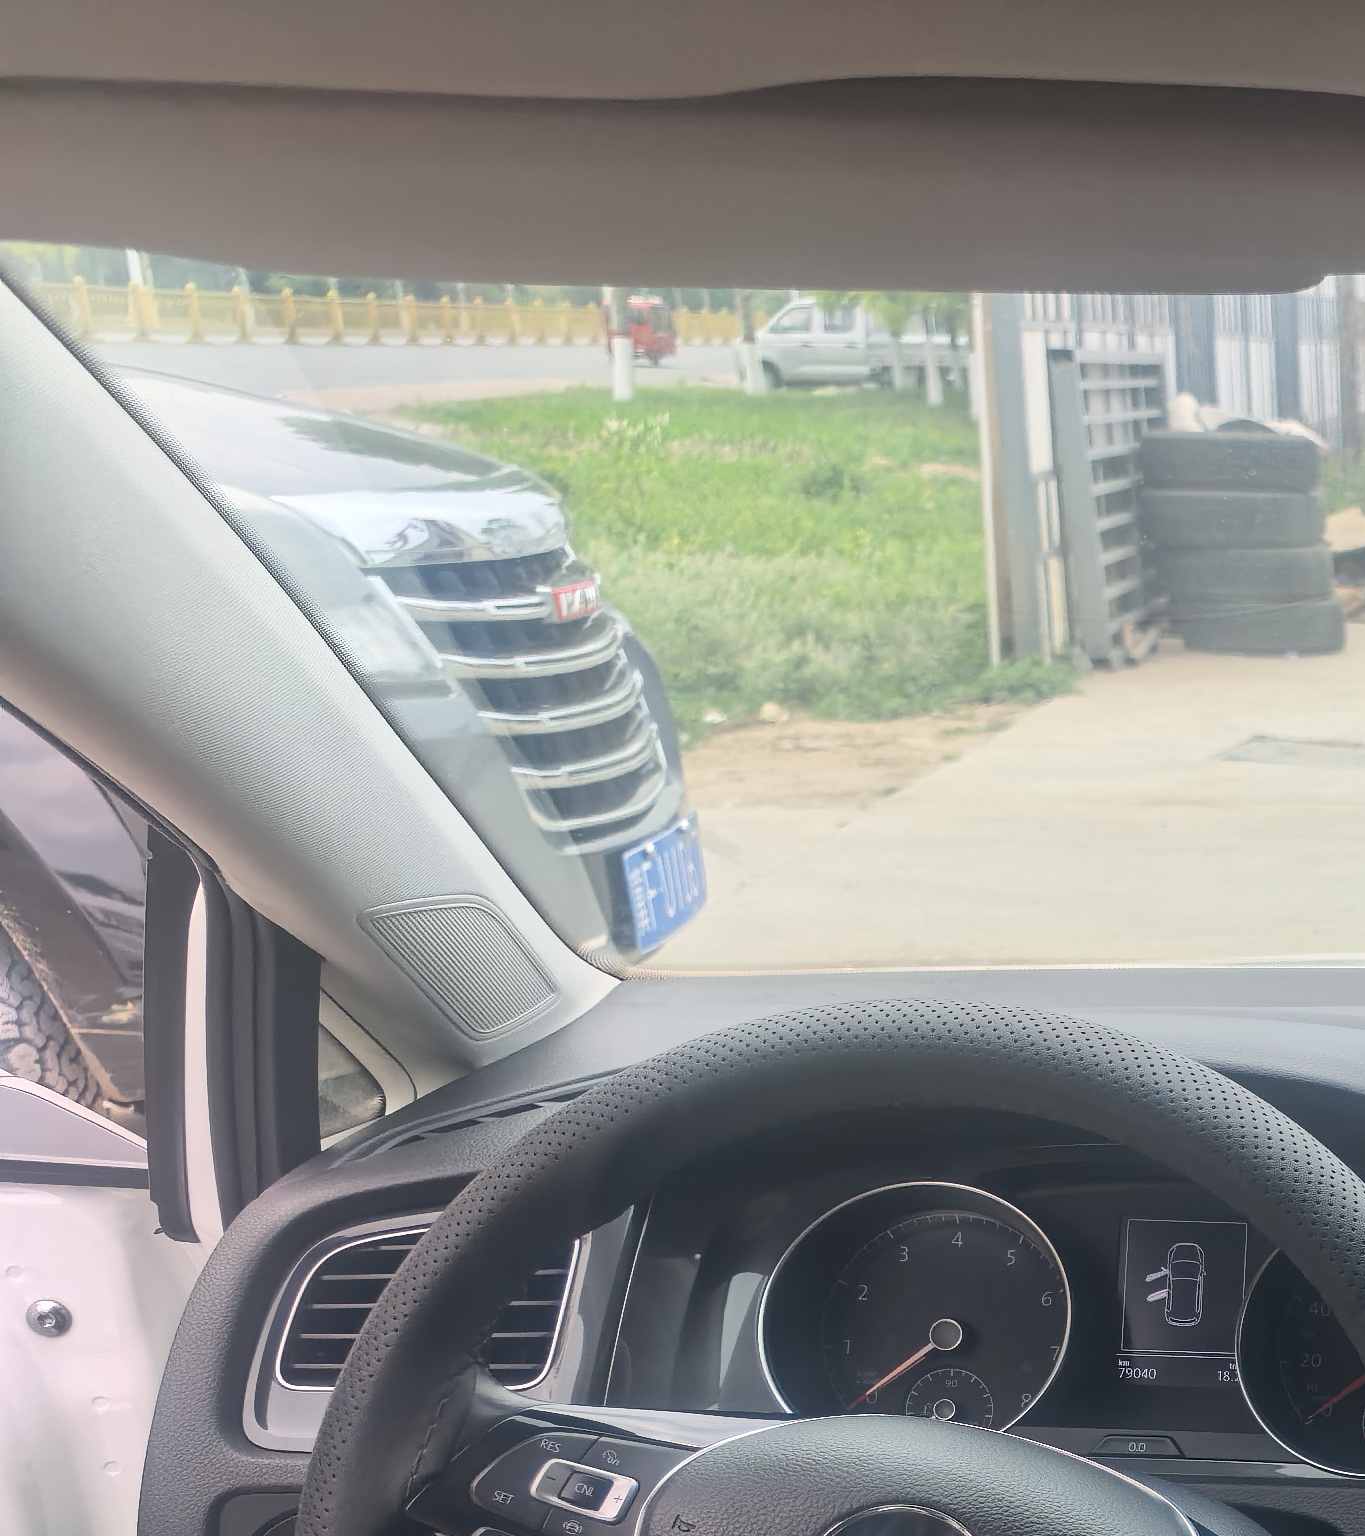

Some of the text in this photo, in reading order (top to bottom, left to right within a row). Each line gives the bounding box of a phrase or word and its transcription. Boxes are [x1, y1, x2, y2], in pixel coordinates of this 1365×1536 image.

[952, 1232, 963, 1248] 4
[899, 1246, 910, 1262] 3
[1007, 1250, 1017, 1266] 5
[858, 1284, 869, 1301] 2
[1041, 1291, 1053, 1306] 6
[1118, 1367, 1157, 1380] 79040
[541, 1439, 561, 1453] RES
[494, 1490, 515, 1505] SET
